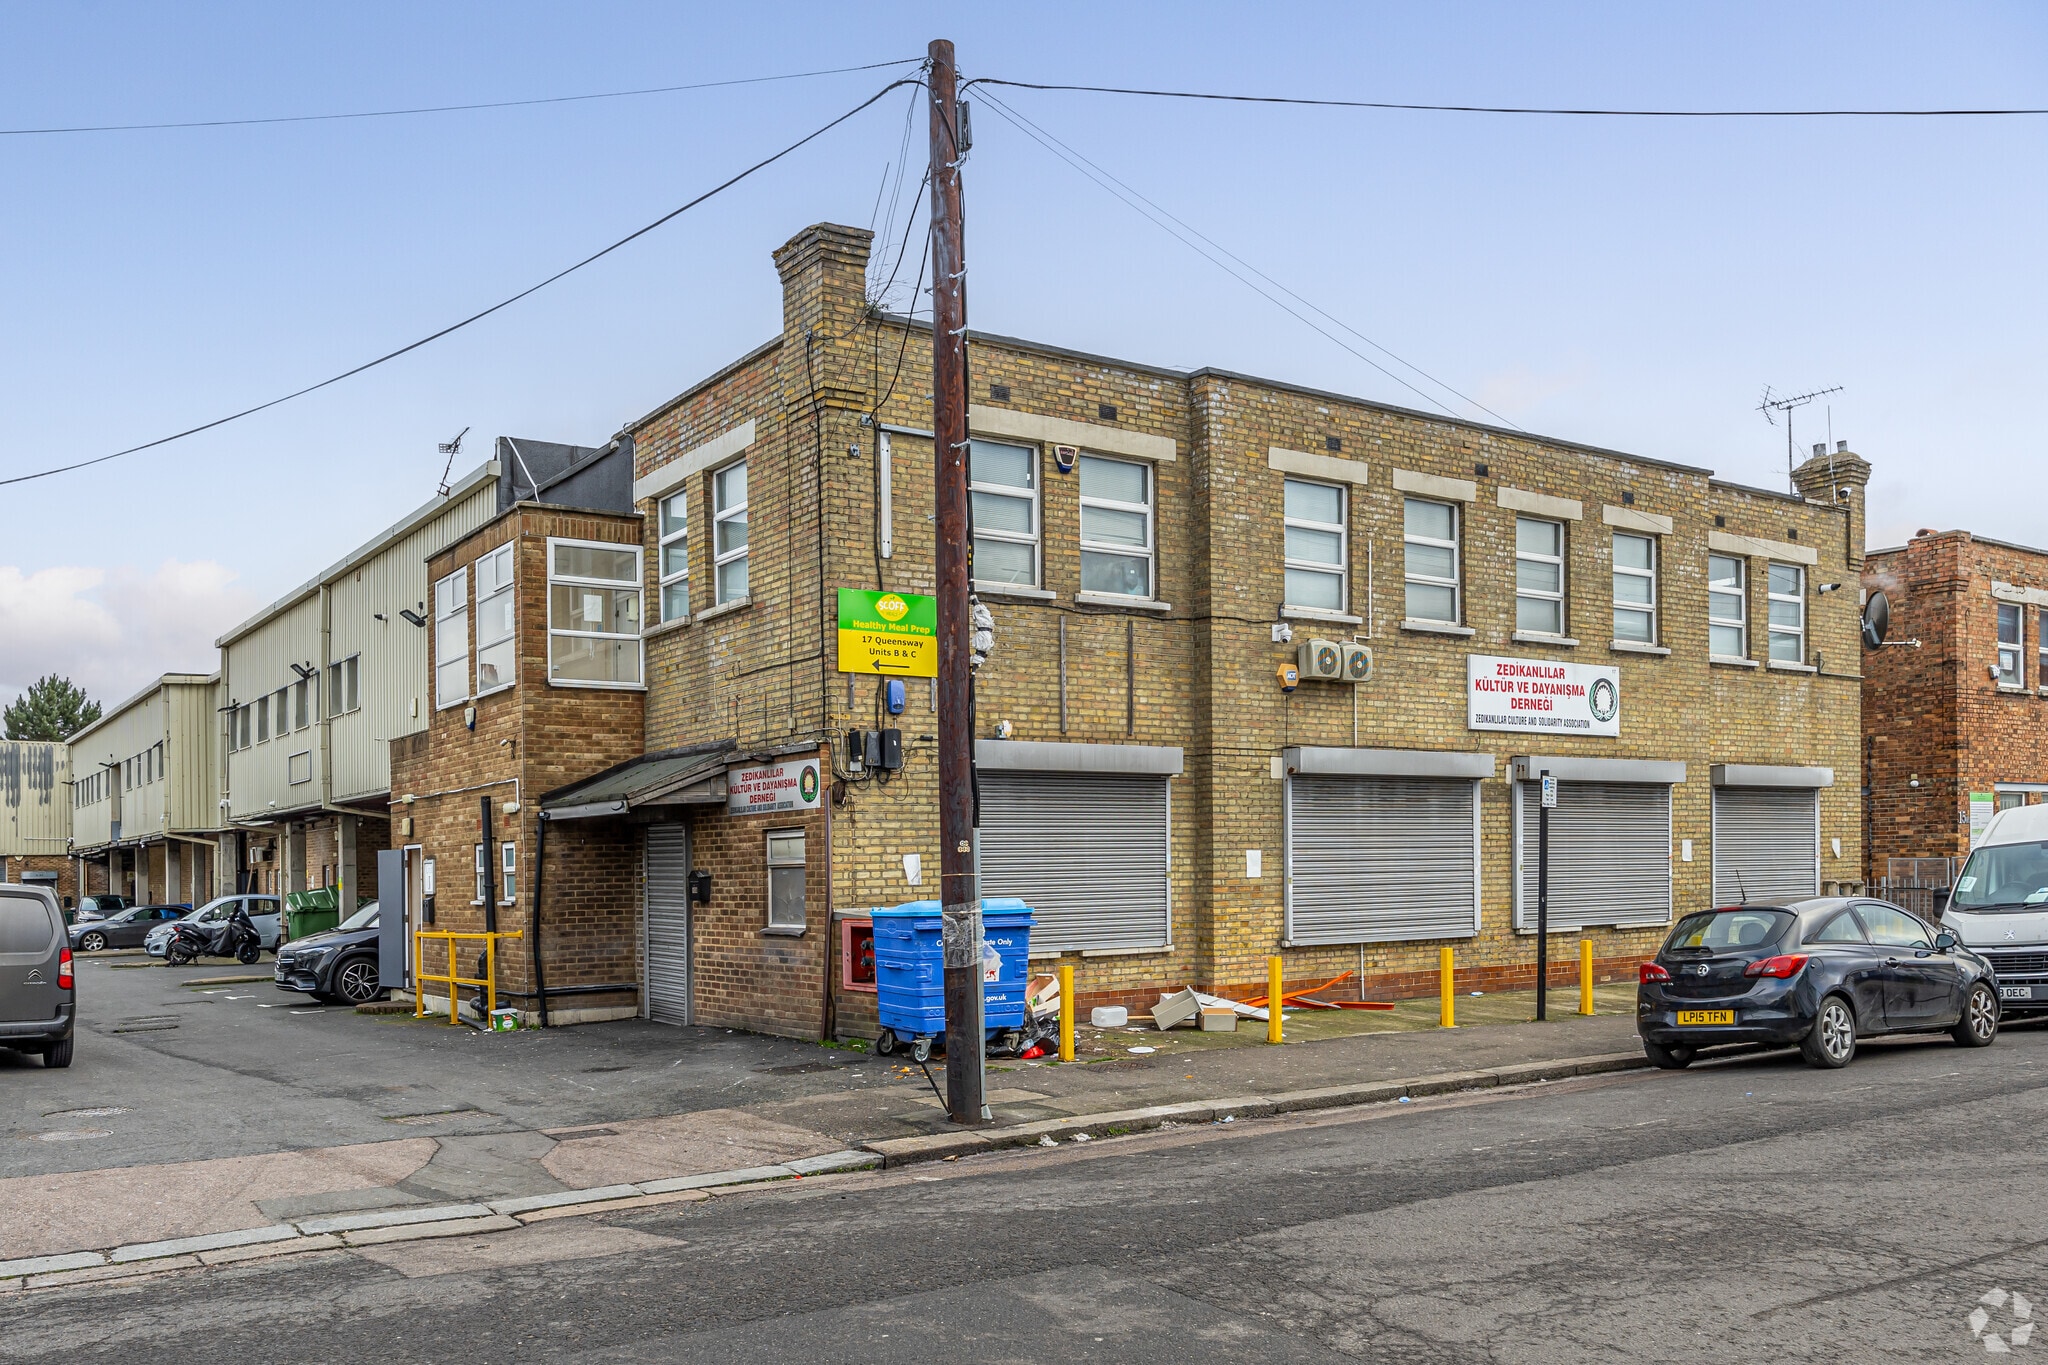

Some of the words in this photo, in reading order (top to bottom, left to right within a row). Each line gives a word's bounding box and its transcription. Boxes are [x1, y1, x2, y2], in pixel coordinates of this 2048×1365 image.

[878, 600, 905, 612] SCOFF
[853, 620, 886, 632] Healthy
[889, 623, 908, 632] Meal
[911, 624, 930, 634] Prep
[862, 635, 872, 643] 17
[875, 636, 923, 648] Queensway
[869, 648, 891, 656] Units
[911, 650, 917, 658] C
[1496, 661, 1565, 680] ZEDİKANLILAR
[1475, 676, 1514, 693] KÜLTÜR
[1517, 682, 1529, 694] VE
[1532, 683, 1585, 700] DAYANIŞMA
[1511, 696, 1553, 711] DERNEĞİ
[1508, 716, 1527, 725] CULTURE
[1528, 717, 1537, 726] AND
[1538, 717, 1562, 727] SOLIDARITY
[1563, 718, 1590, 729] ASSOCIATION
[729, 782, 752, 795] KÜLTÜR
[753, 783, 761, 791] VE
[762, 778, 797, 791] DAYANIŞMA
[749, 789, 776, 804] DERNEĞİ
[997, 938, 1013, 946] Only
[985, 994, 1007, 1002] .gov.uk
[2006, 988, 2025, 997] OEC
[1683, 1010, 1705, 1022] LP15
[1707, 1011, 1727, 1022] TFN
